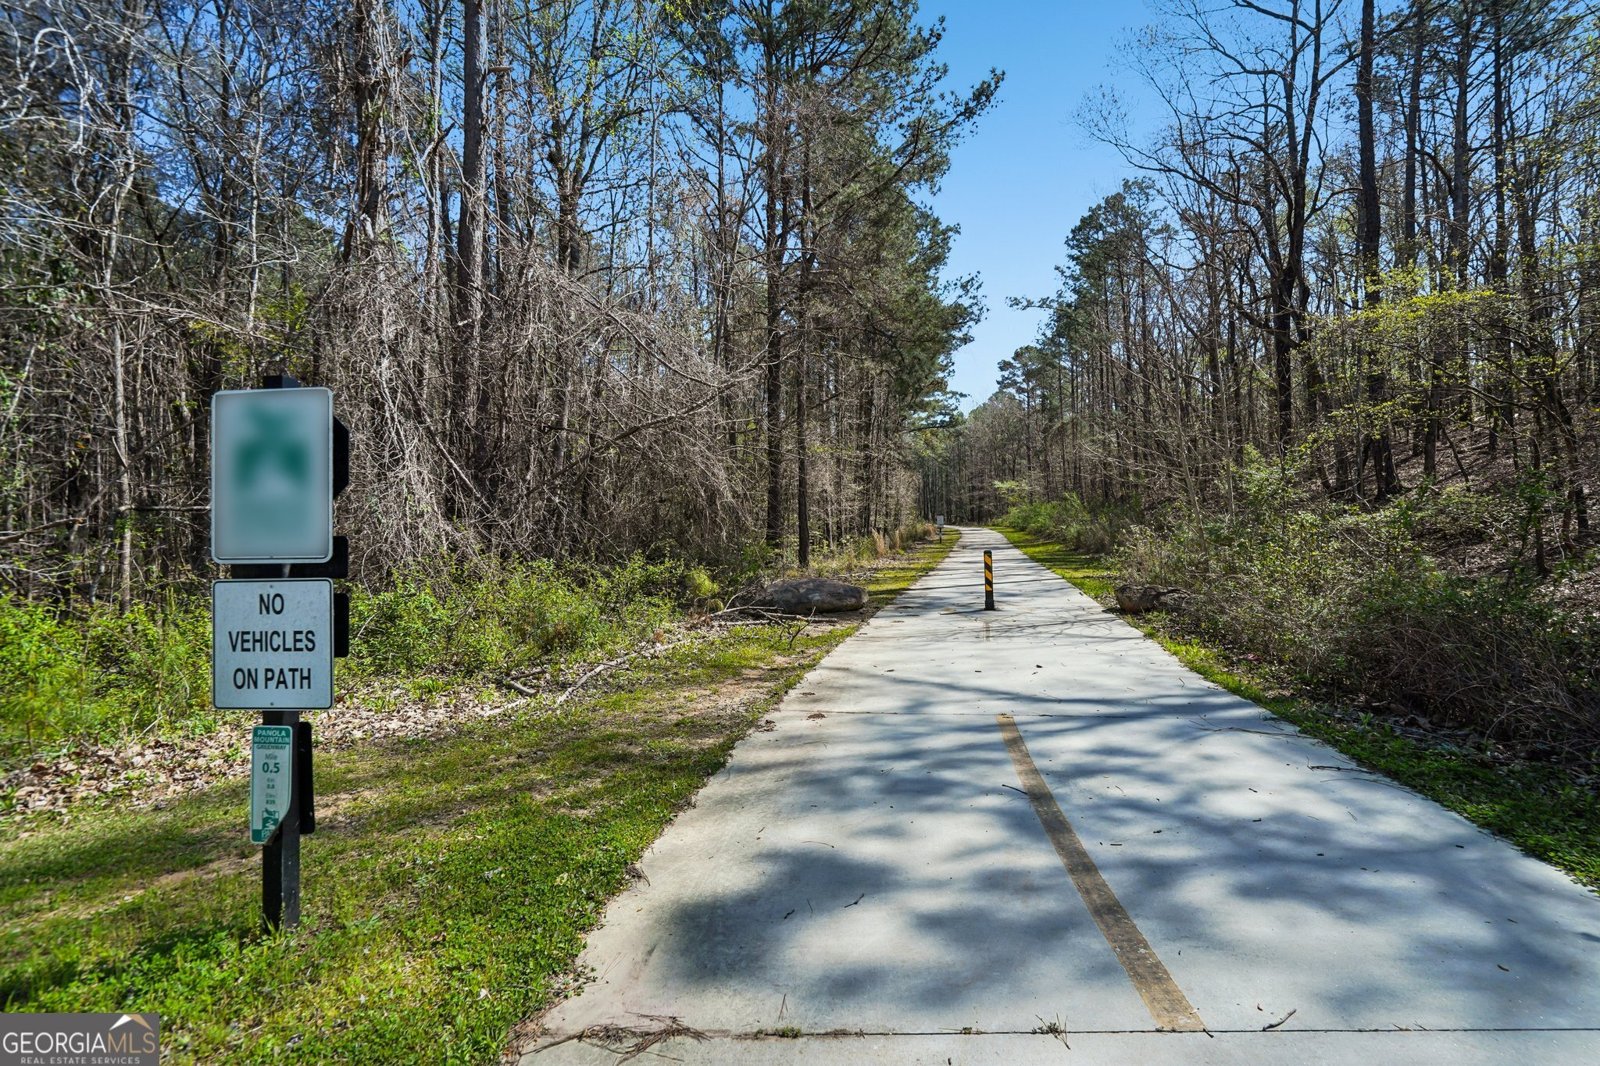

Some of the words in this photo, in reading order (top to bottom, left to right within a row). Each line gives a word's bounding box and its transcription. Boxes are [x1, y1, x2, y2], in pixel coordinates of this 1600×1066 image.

[259, 593, 284, 614] NO
[228, 630, 316, 652] VEHICLES
[233, 668, 258, 689] ON
[265, 668, 311, 689] PATH
[262, 762, 280, 773] 0.5
